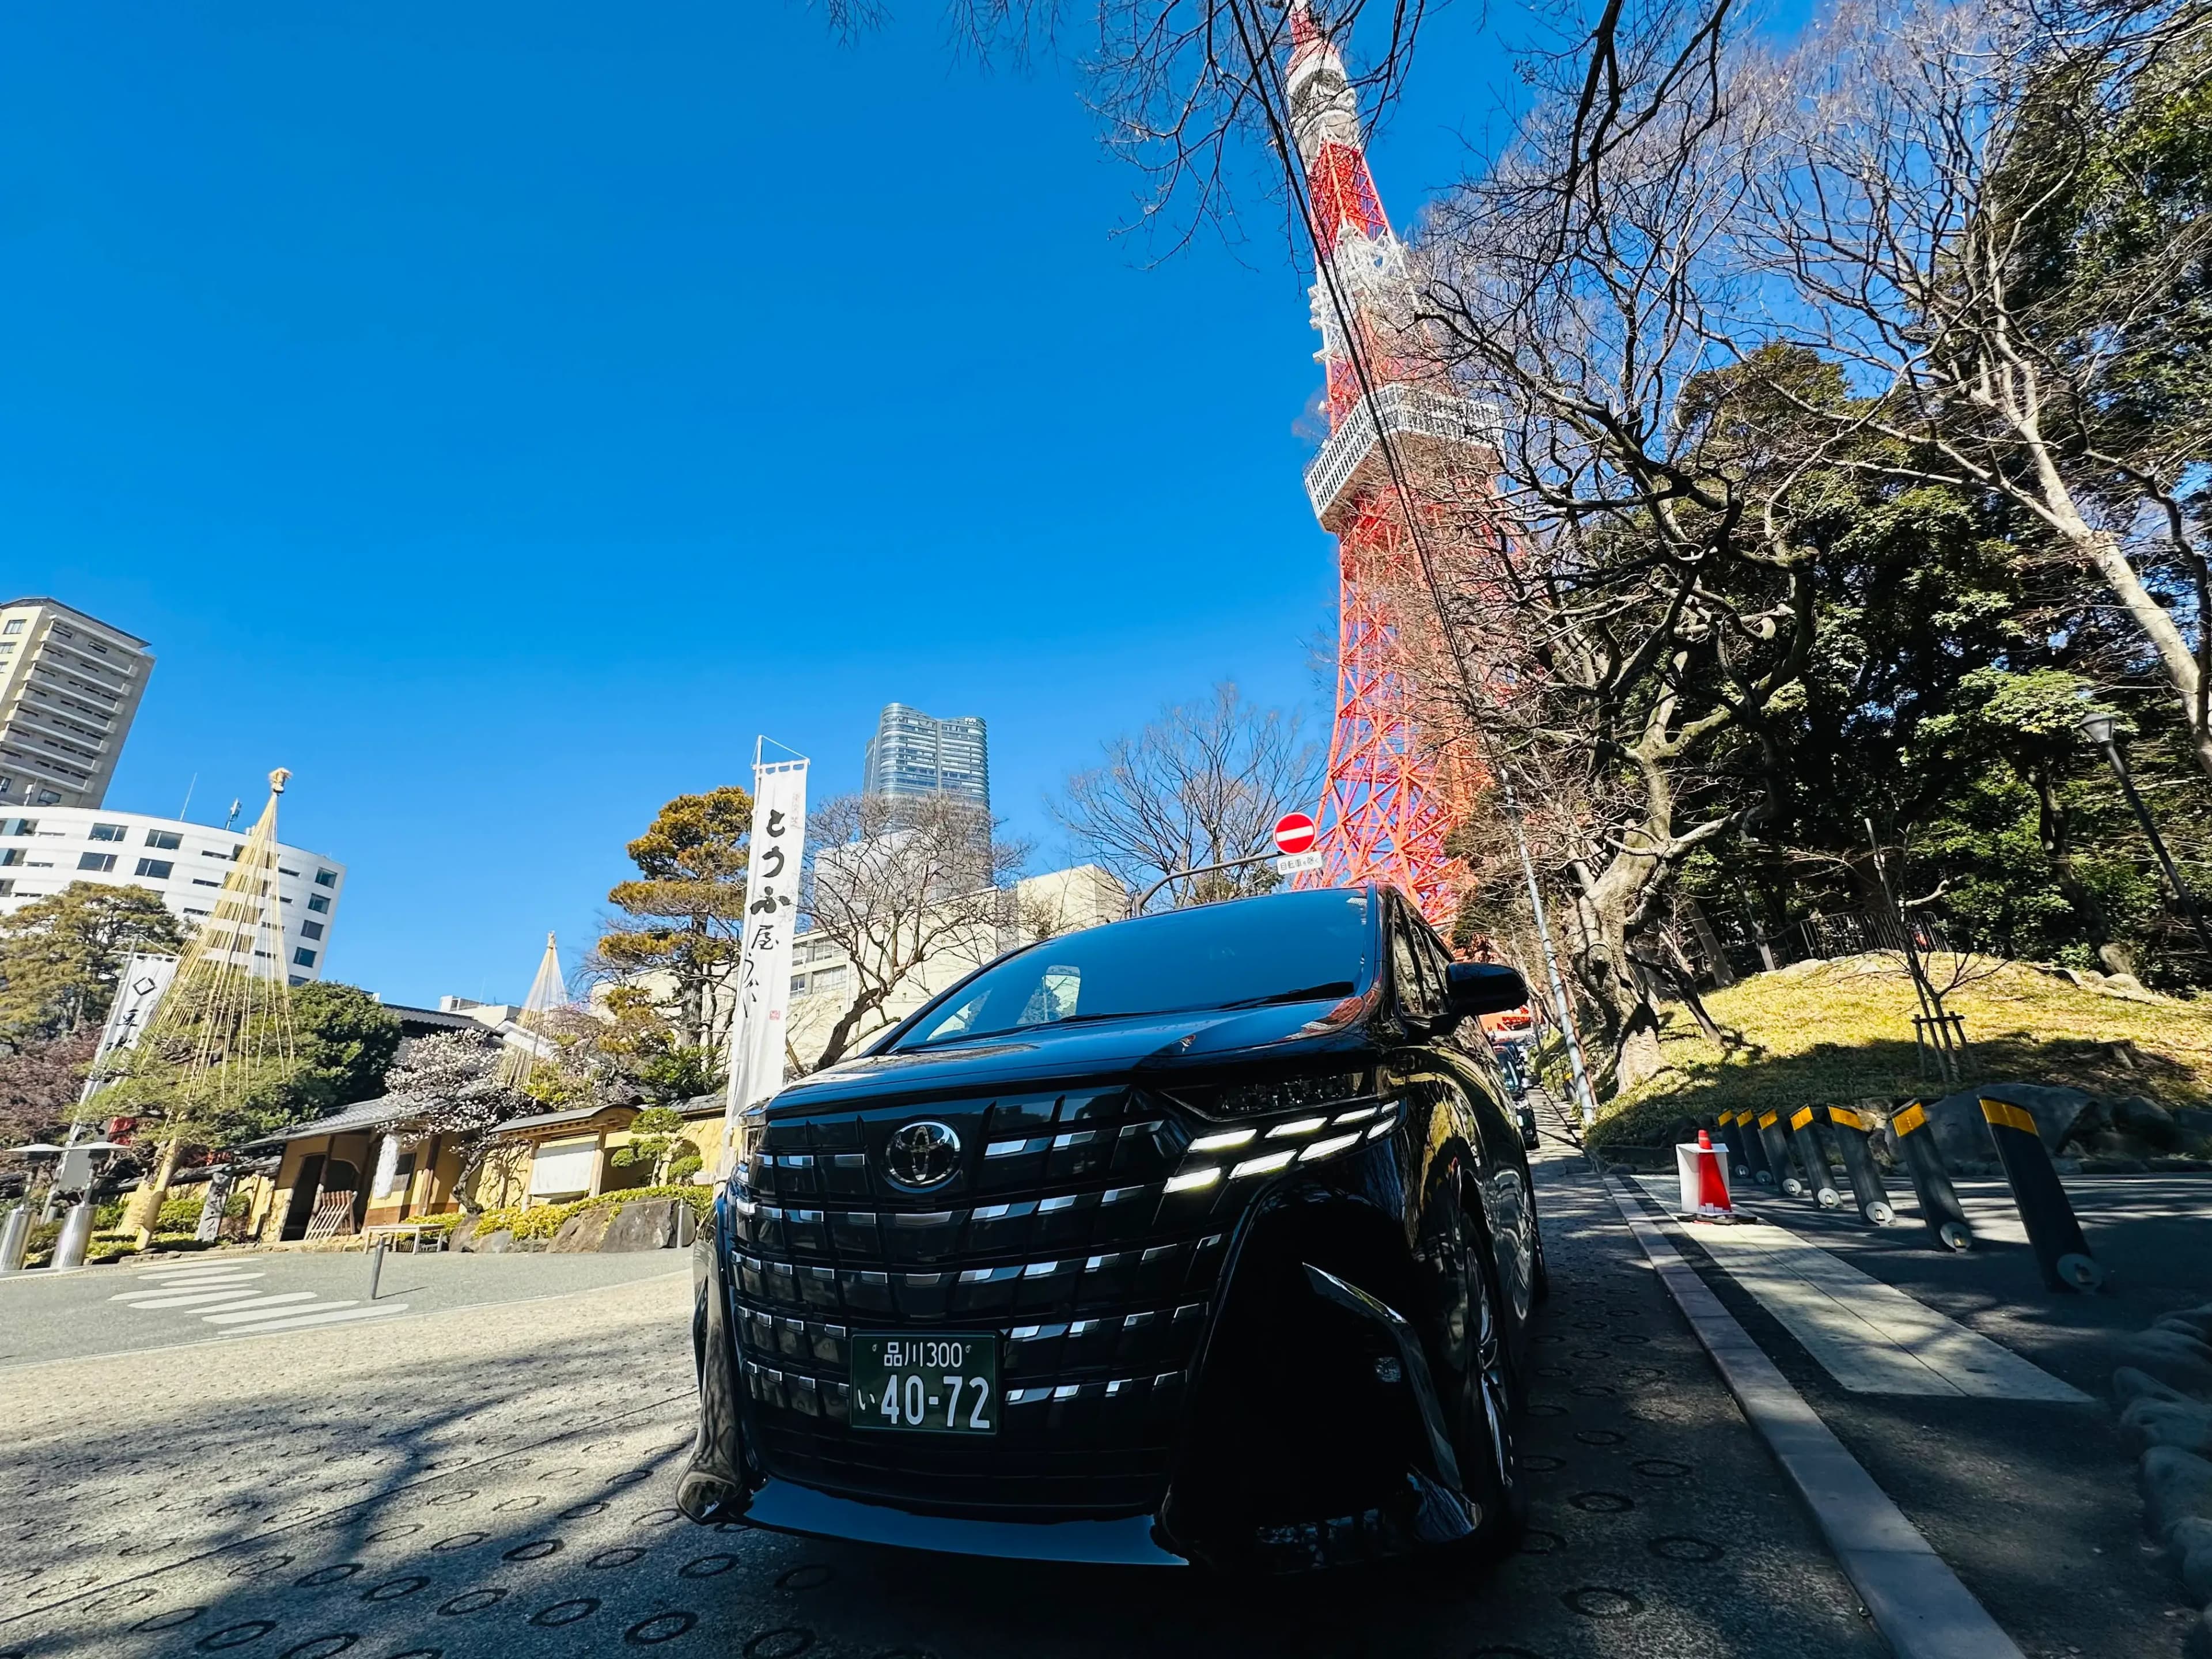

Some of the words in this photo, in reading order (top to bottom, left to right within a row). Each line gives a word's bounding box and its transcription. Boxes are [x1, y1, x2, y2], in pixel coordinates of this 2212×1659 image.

[884, 1342, 963, 1368] 品川300
[857, 1388, 876, 1411] い
[881, 1374, 990, 1429] 40-72
